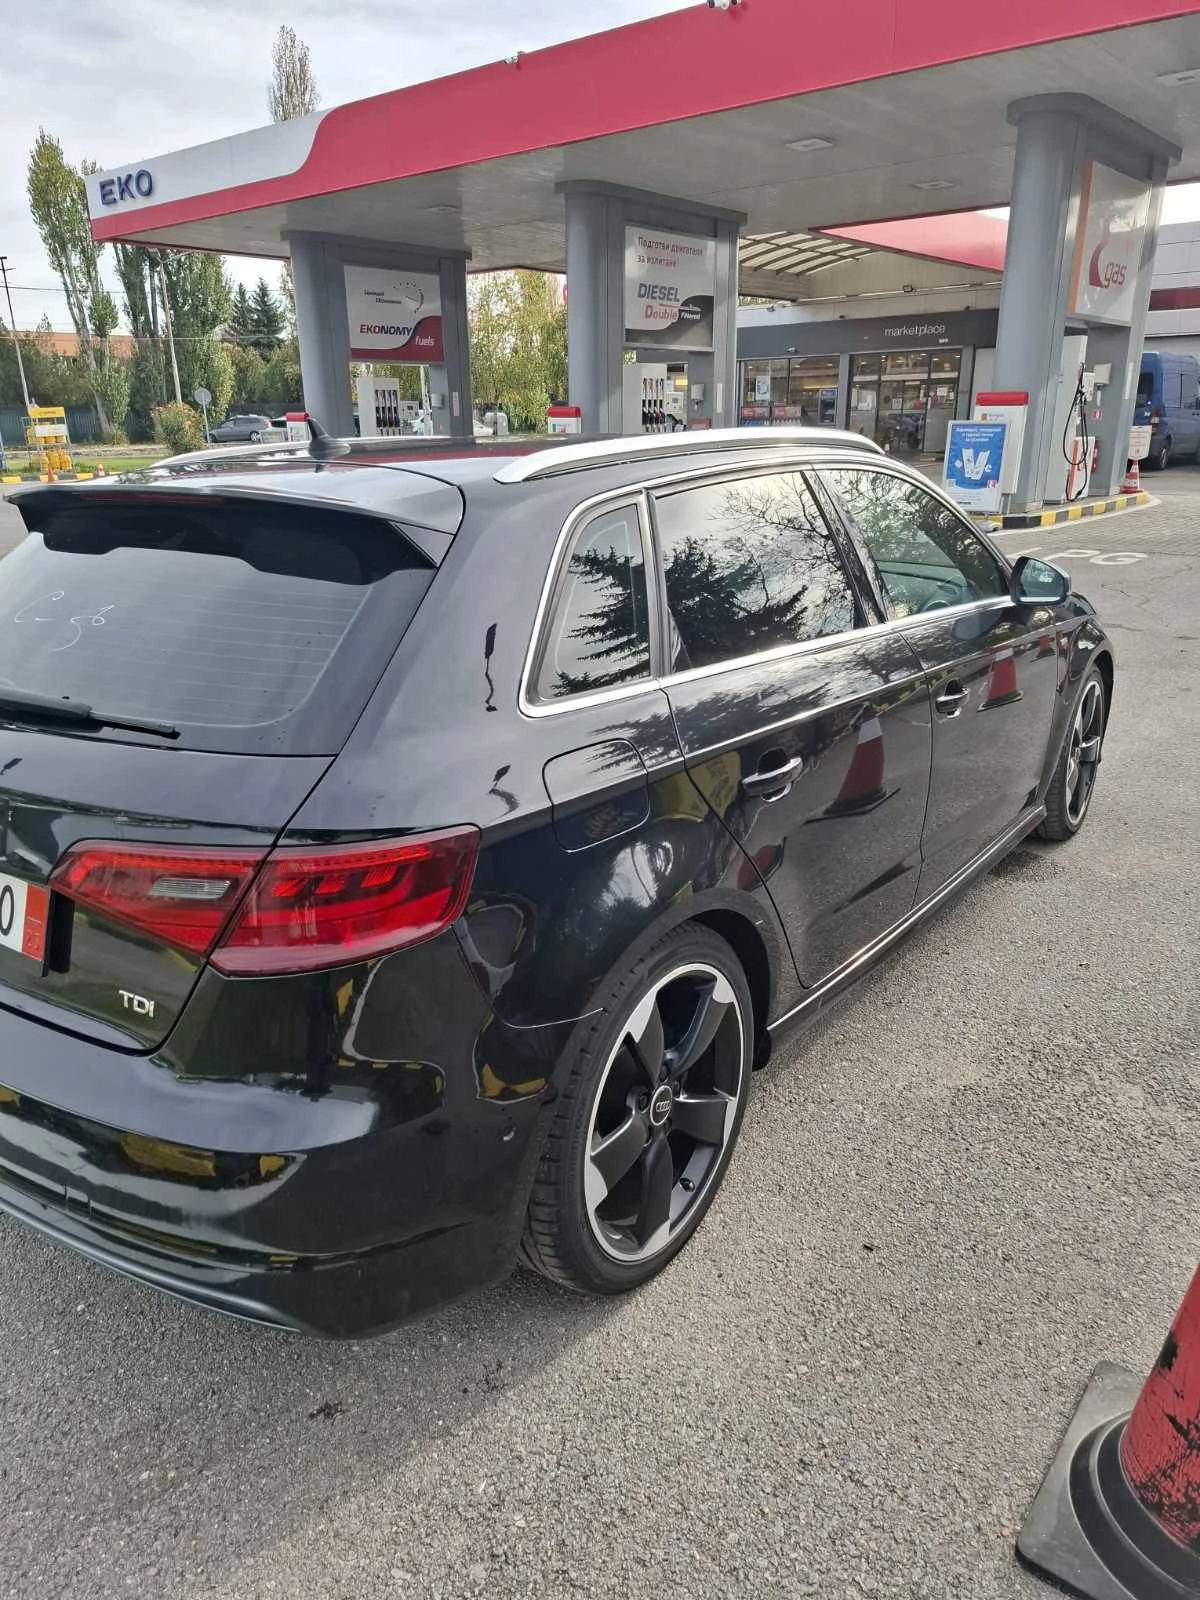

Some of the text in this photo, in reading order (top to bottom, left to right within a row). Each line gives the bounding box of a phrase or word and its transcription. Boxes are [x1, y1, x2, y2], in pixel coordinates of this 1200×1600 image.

[99, 169, 153, 205] EKO
[1102, 261, 1127, 288] gas
[638, 283, 680, 302] DIESEL
[645, 304, 677, 320] Double
[360, 323, 435, 347] EKONOMY fuels
[884, 323, 946, 337] marketplace
[118, 989, 155, 1018] TDI
